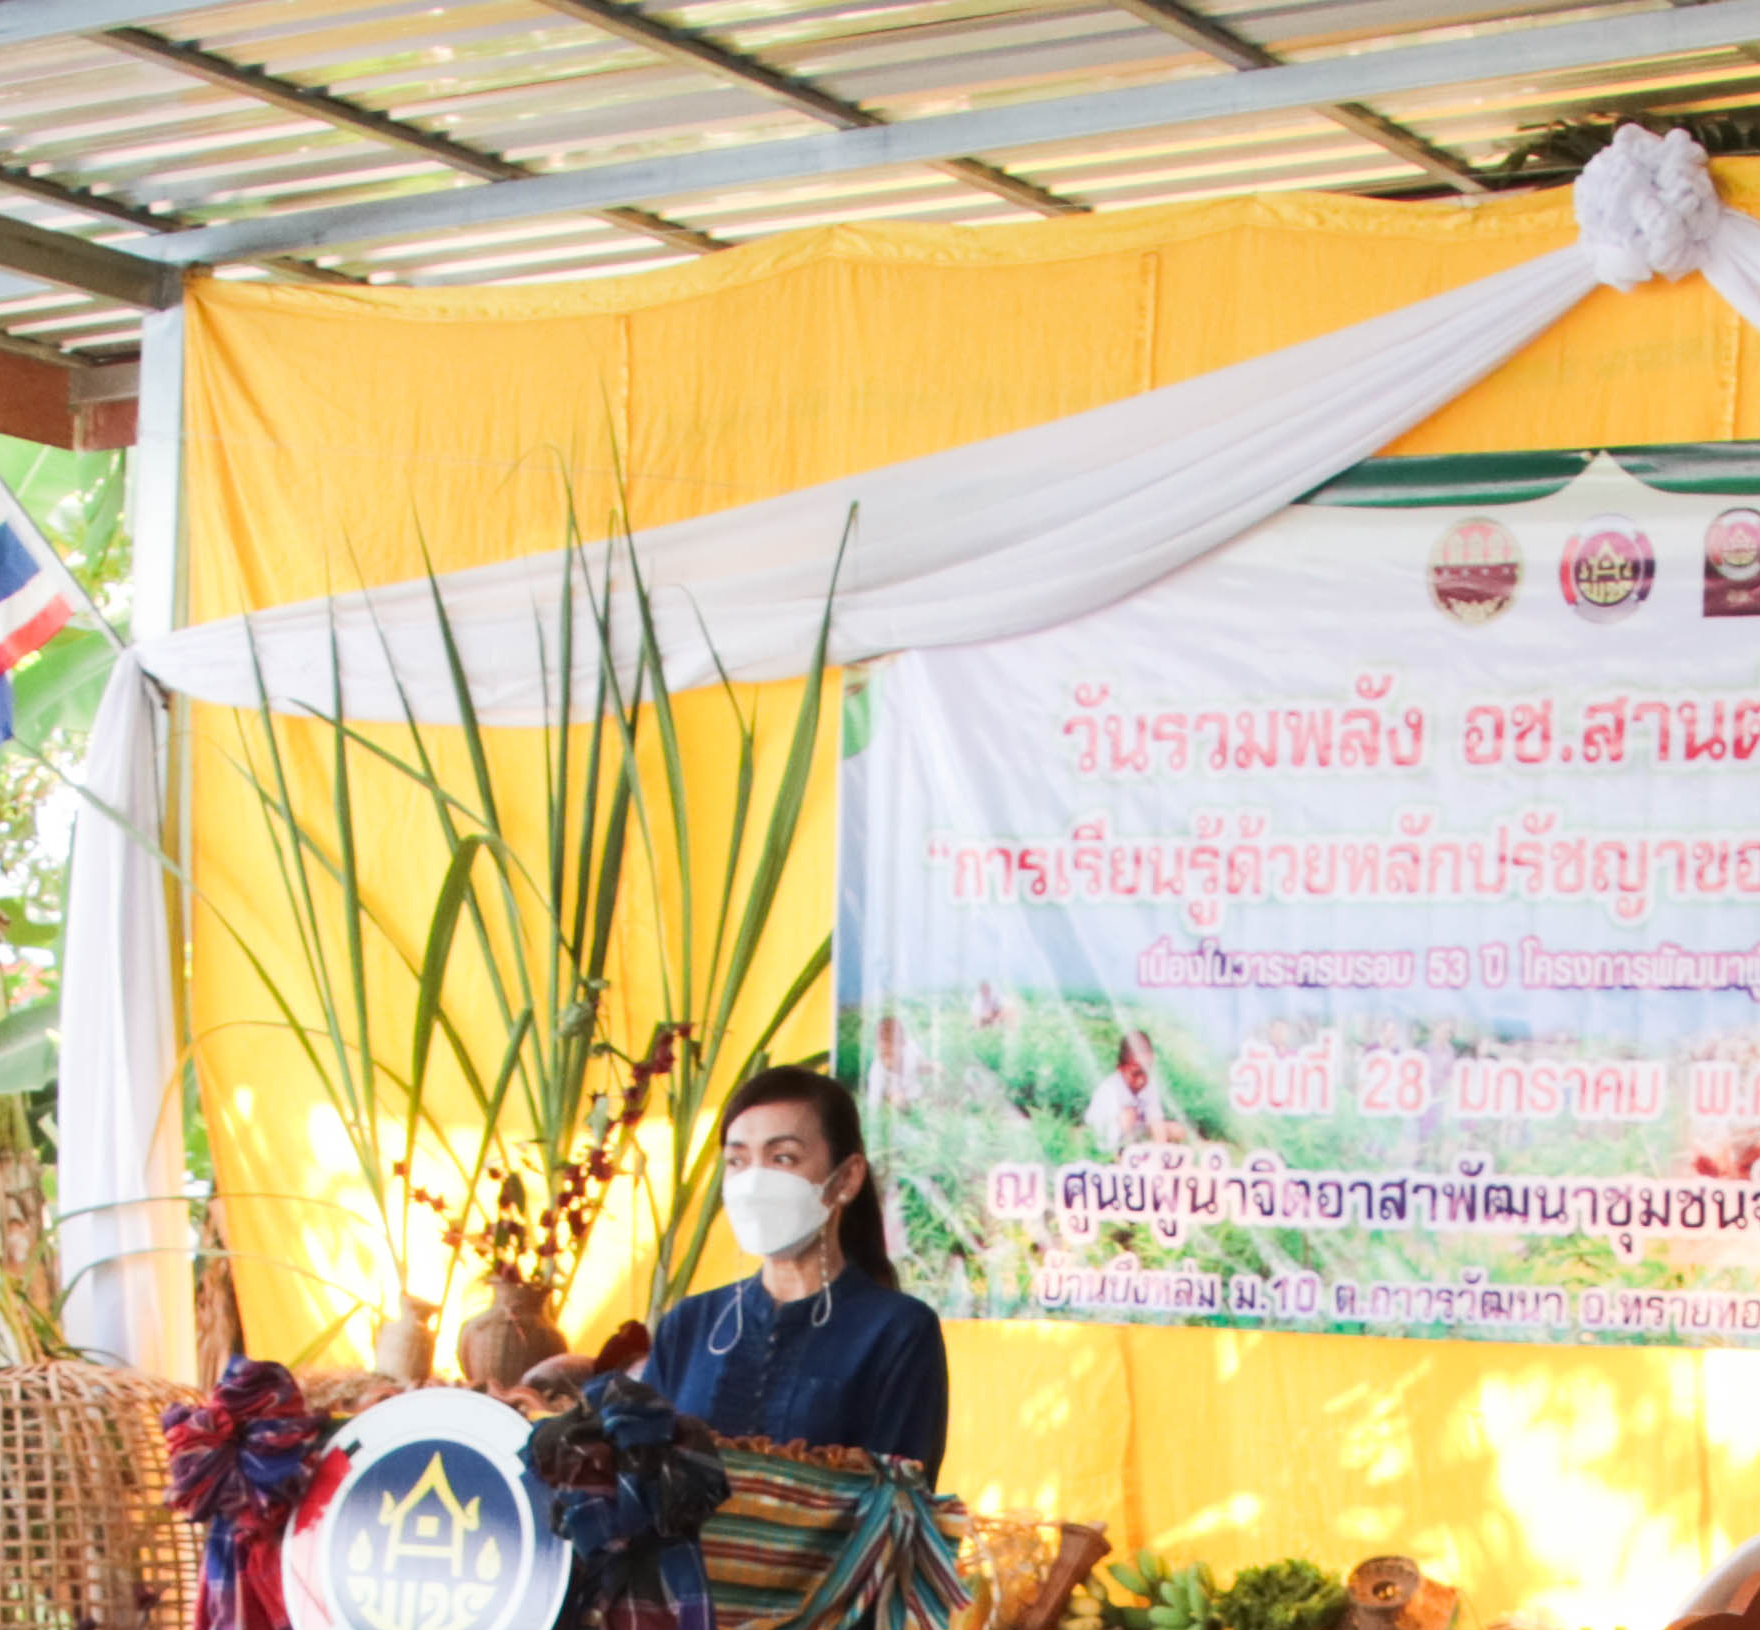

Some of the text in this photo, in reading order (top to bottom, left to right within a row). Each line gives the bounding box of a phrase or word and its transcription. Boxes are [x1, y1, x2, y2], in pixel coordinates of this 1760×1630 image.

[1062, 673, 1425, 772] วันรวมพลัง
[1428, 948, 1469, 987] 53
[1481, 944, 1505, 987] ปี
[1234, 1036, 1329, 1112] วันที่
[1366, 1054, 1428, 1111] 28
[1458, 1058, 1660, 1117] มกราคม
[996, 1168, 1037, 1211] ณ
[1231, 1272, 1318, 1317] ม.10
[1336, 1272, 1565, 1324] ต.ถาวรวัฒนา
